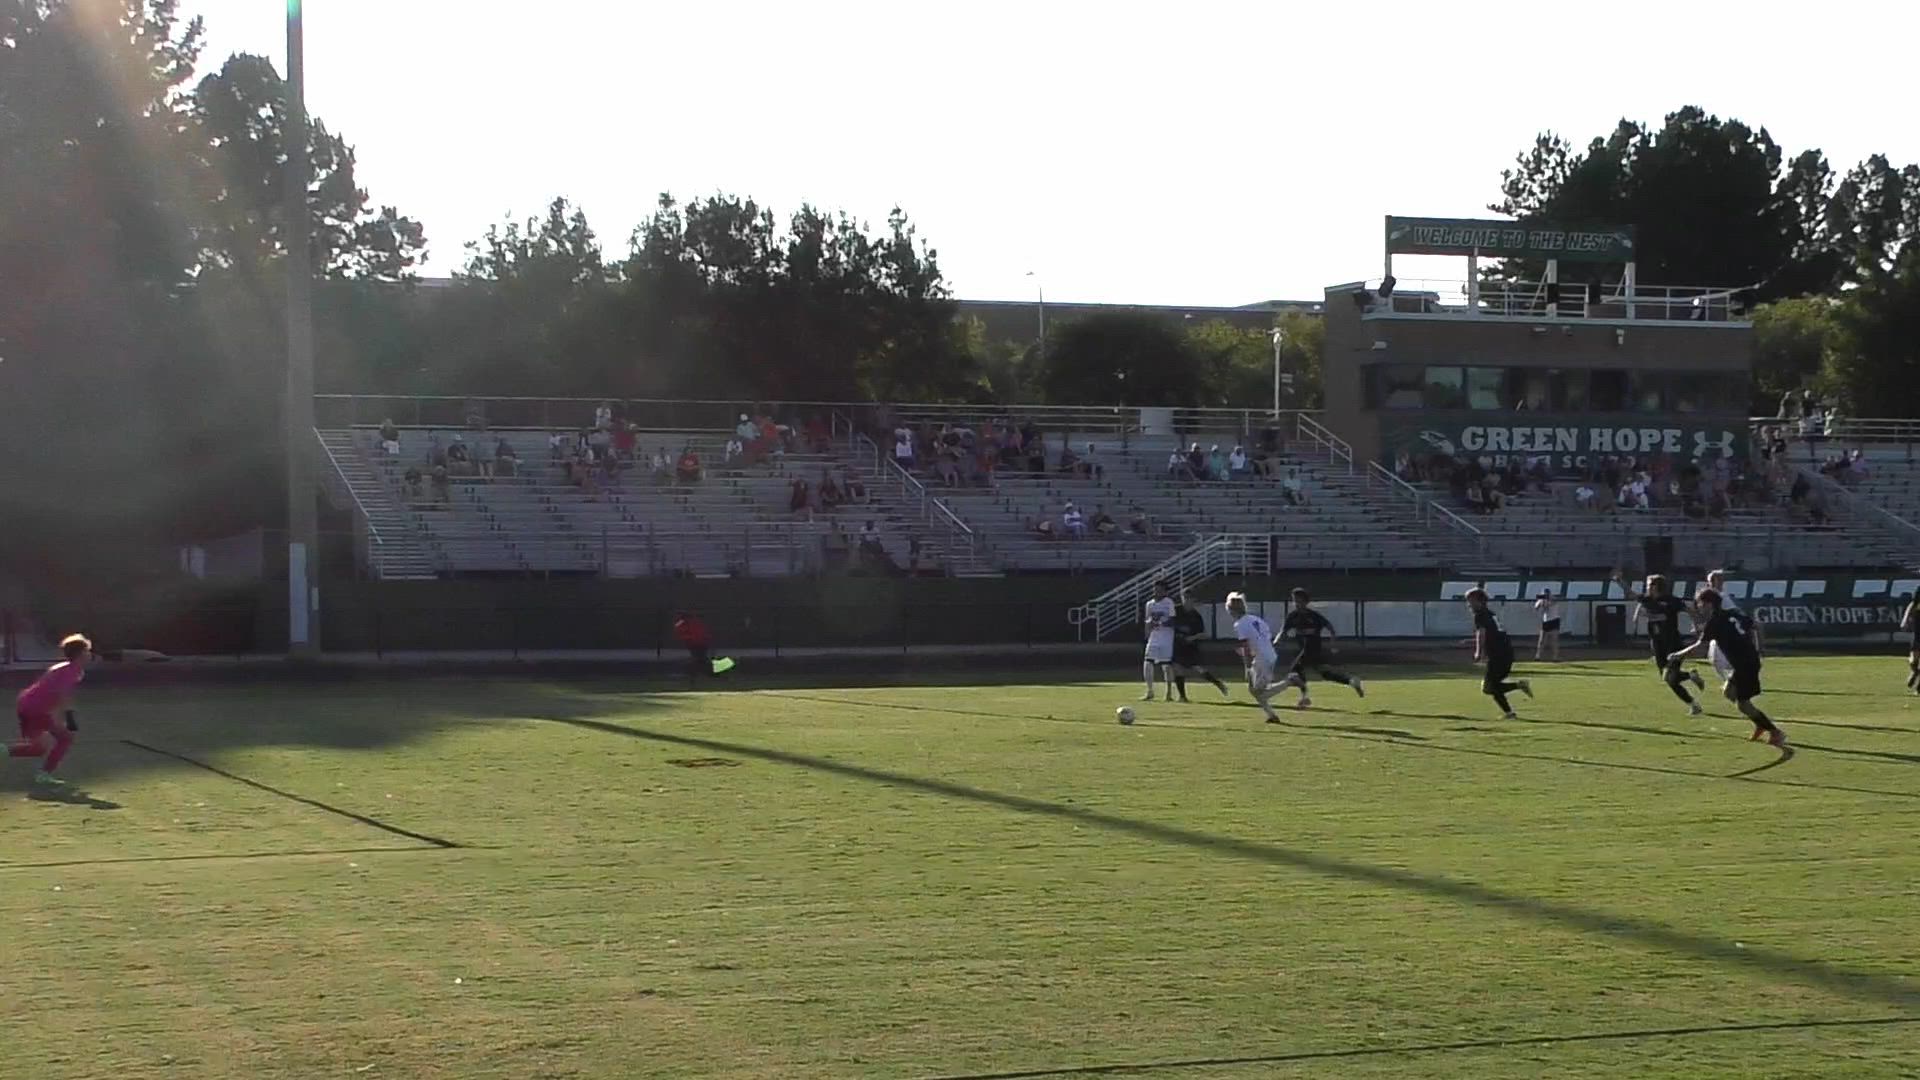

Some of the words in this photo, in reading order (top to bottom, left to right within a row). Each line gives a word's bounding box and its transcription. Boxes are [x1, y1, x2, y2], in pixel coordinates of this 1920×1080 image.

[1413, 226, 1499, 248] WELCOME
[1502, 229, 1526, 249] TO
[1529, 230, 1566, 250] THE
[1567, 232, 1614, 251] NEST
[1461, 426, 1578, 452] GREEN
[1589, 428, 1682, 453] HOPE
[1754, 606, 1816, 624] GREEN
[1821, 607, 1874, 624] HOPE
